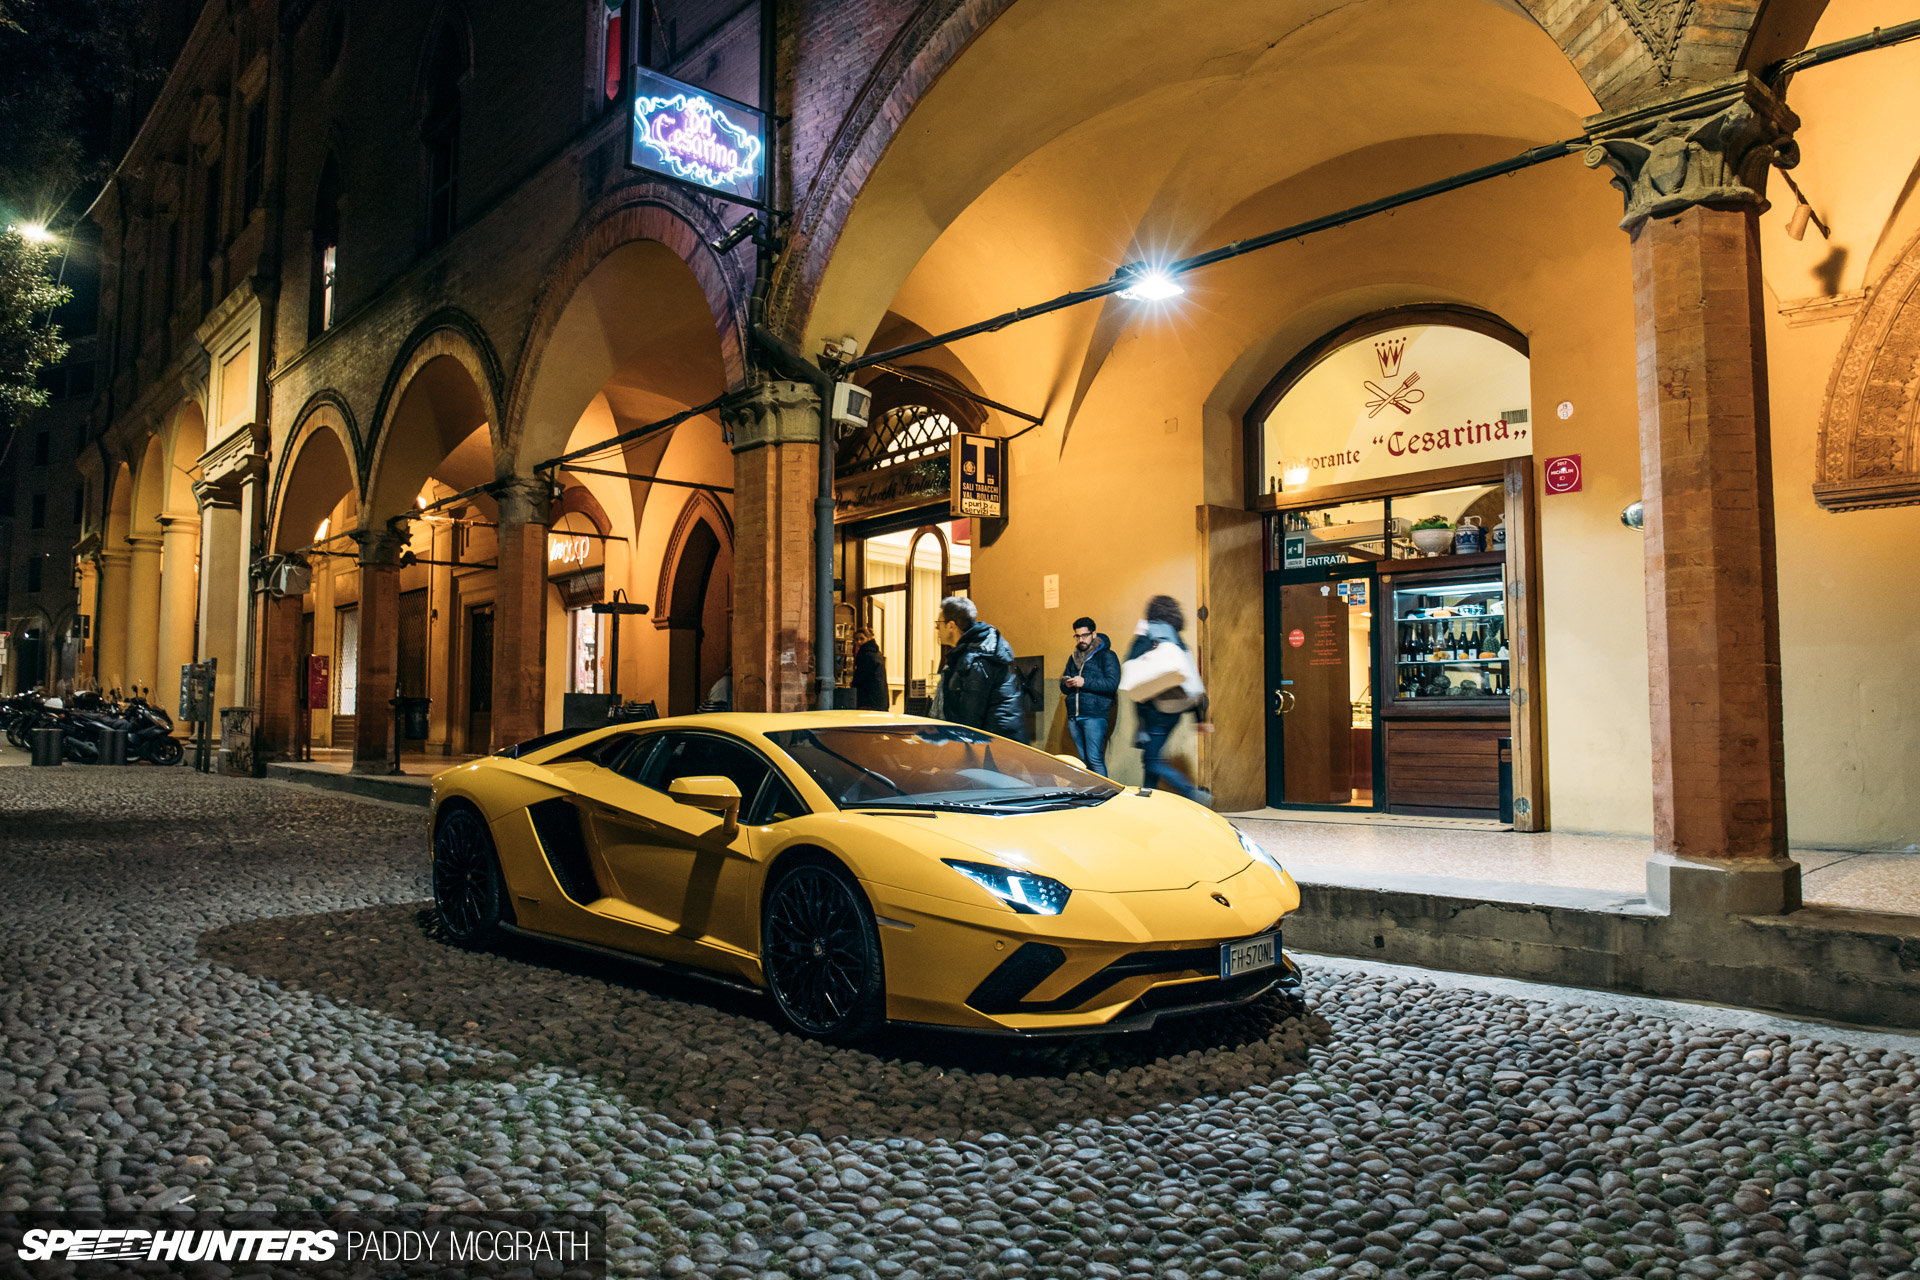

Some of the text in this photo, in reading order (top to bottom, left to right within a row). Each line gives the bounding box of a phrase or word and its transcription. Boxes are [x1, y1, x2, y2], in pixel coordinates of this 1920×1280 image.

[655, 113, 738, 168] Cesarina
[966, 436, 995, 484] T
[962, 482, 999, 494] SALI TABACCHI
[1306, 554, 1347, 567] ENTRATA
